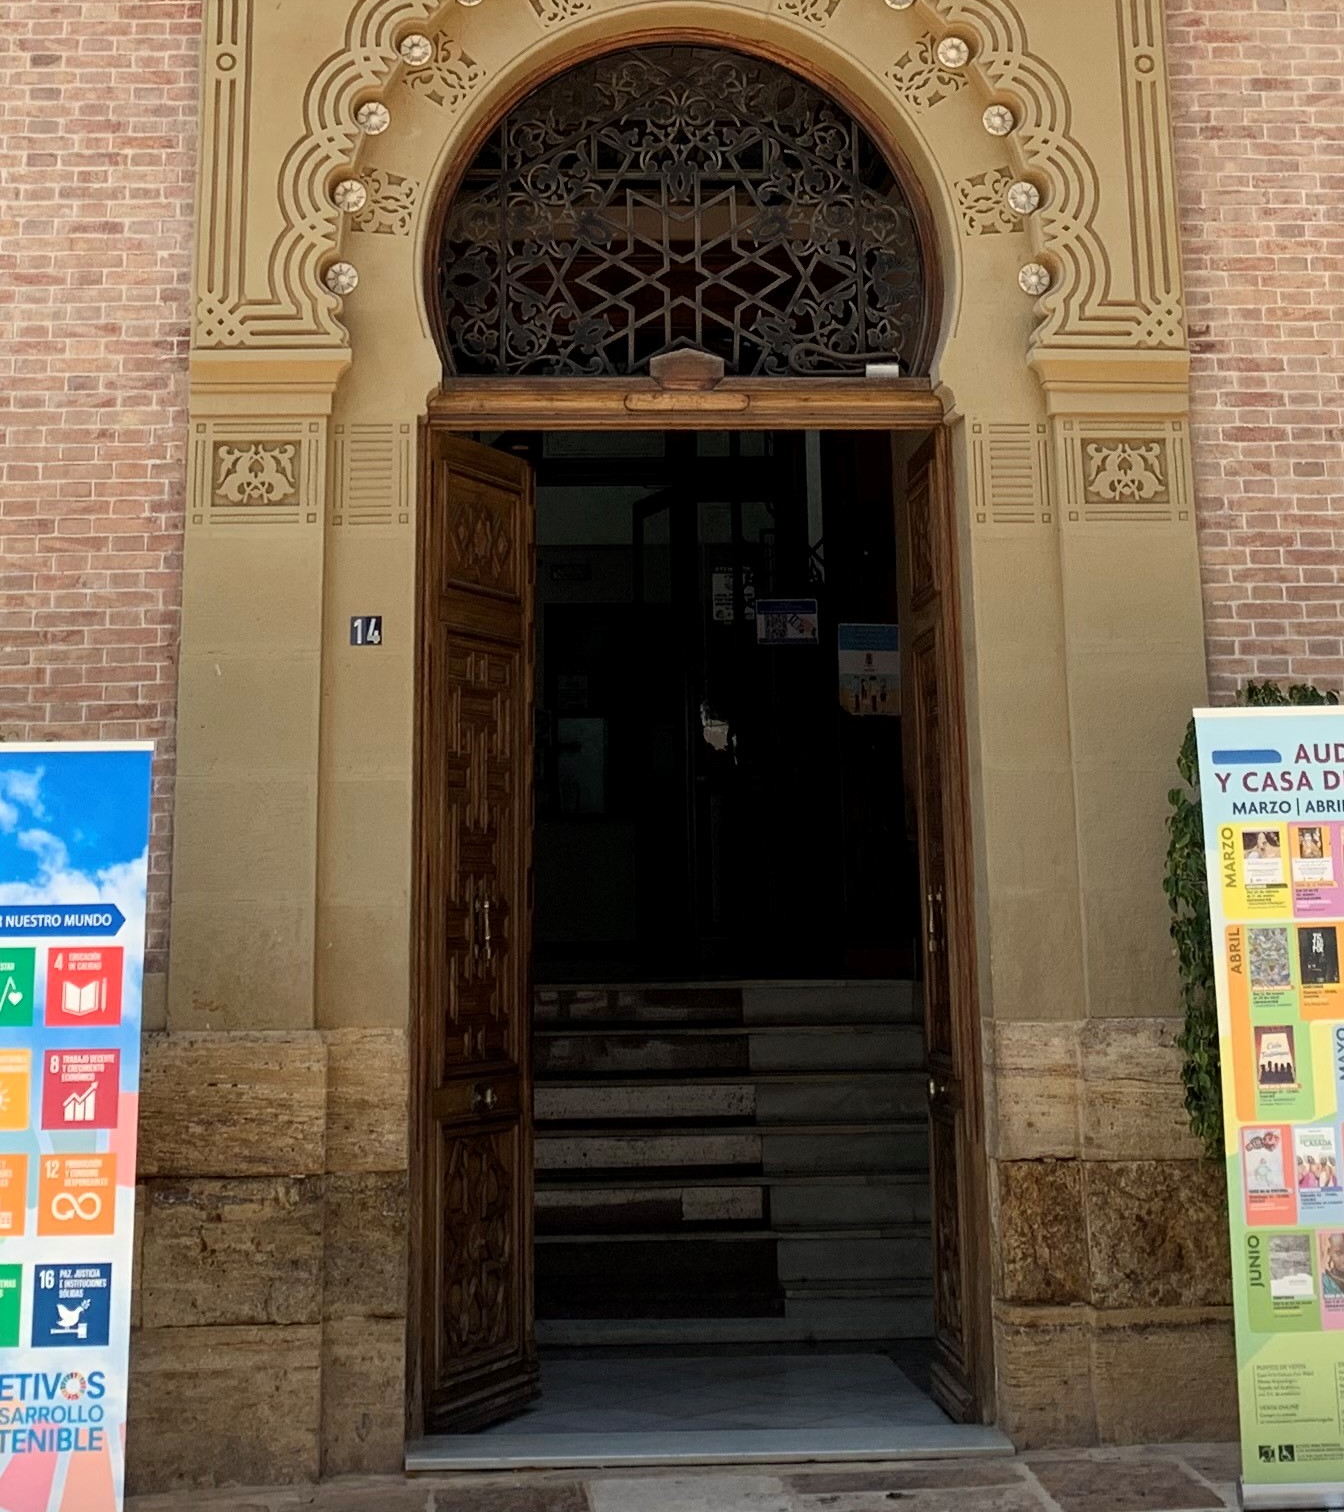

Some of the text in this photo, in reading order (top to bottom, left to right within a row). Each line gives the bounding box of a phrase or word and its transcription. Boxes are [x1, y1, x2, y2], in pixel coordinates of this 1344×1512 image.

[353, 618, 381, 644] 14
[1214, 772, 1232, 793] Y
[1242, 770, 1314, 792] CASA
[1232, 800, 1292, 815] MARZO
[1220, 827, 1237, 888] MARZO
[5, 914, 62, 928] NUESTRO
[64, 913, 112, 927] MUNDO
[1229, 928, 1242, 975] ABRIL
[53, 953, 64, 971] 4
[50, 1055, 60, 1074] 8
[45, 1160, 60, 1179] 12
[1247, 1235, 1265, 1288] JUNIO
[39, 1269, 55, 1289] 16
